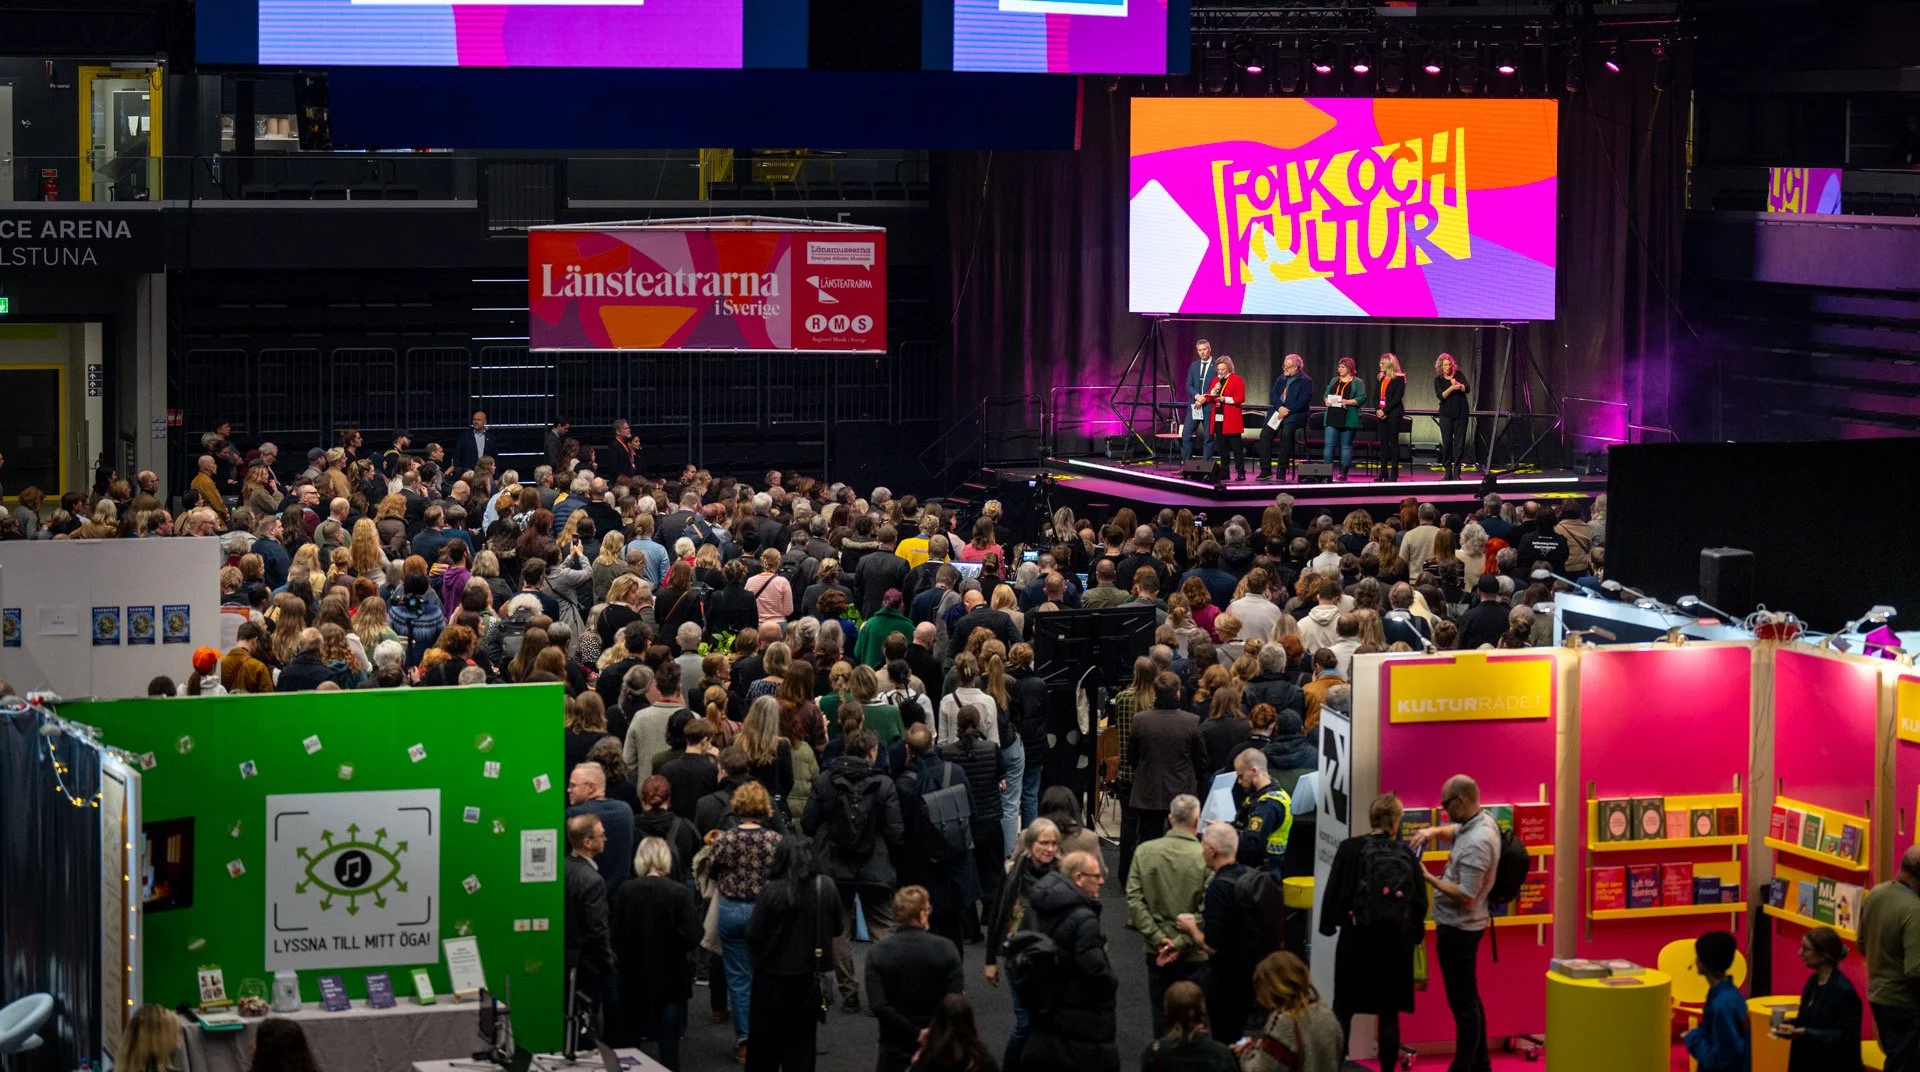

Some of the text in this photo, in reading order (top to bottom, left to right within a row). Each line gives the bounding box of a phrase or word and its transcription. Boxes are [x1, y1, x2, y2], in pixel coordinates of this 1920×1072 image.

[1222, 127, 1457, 217] FOLK OCH
[0, 220, 132, 239] CE ARENA
[811, 245, 871, 254] Länsmuseerna
[1229, 202, 1457, 286] KULTUR
[0, 247, 98, 266] LSTUNA
[541, 263, 779, 297] Länsteatrarna
[820, 277, 872, 289] LÄNSTEATRARNA
[715, 299, 780, 320] i Sverige
[274, 930, 431, 954] LYSSNA TILL MITT ÖGA!
